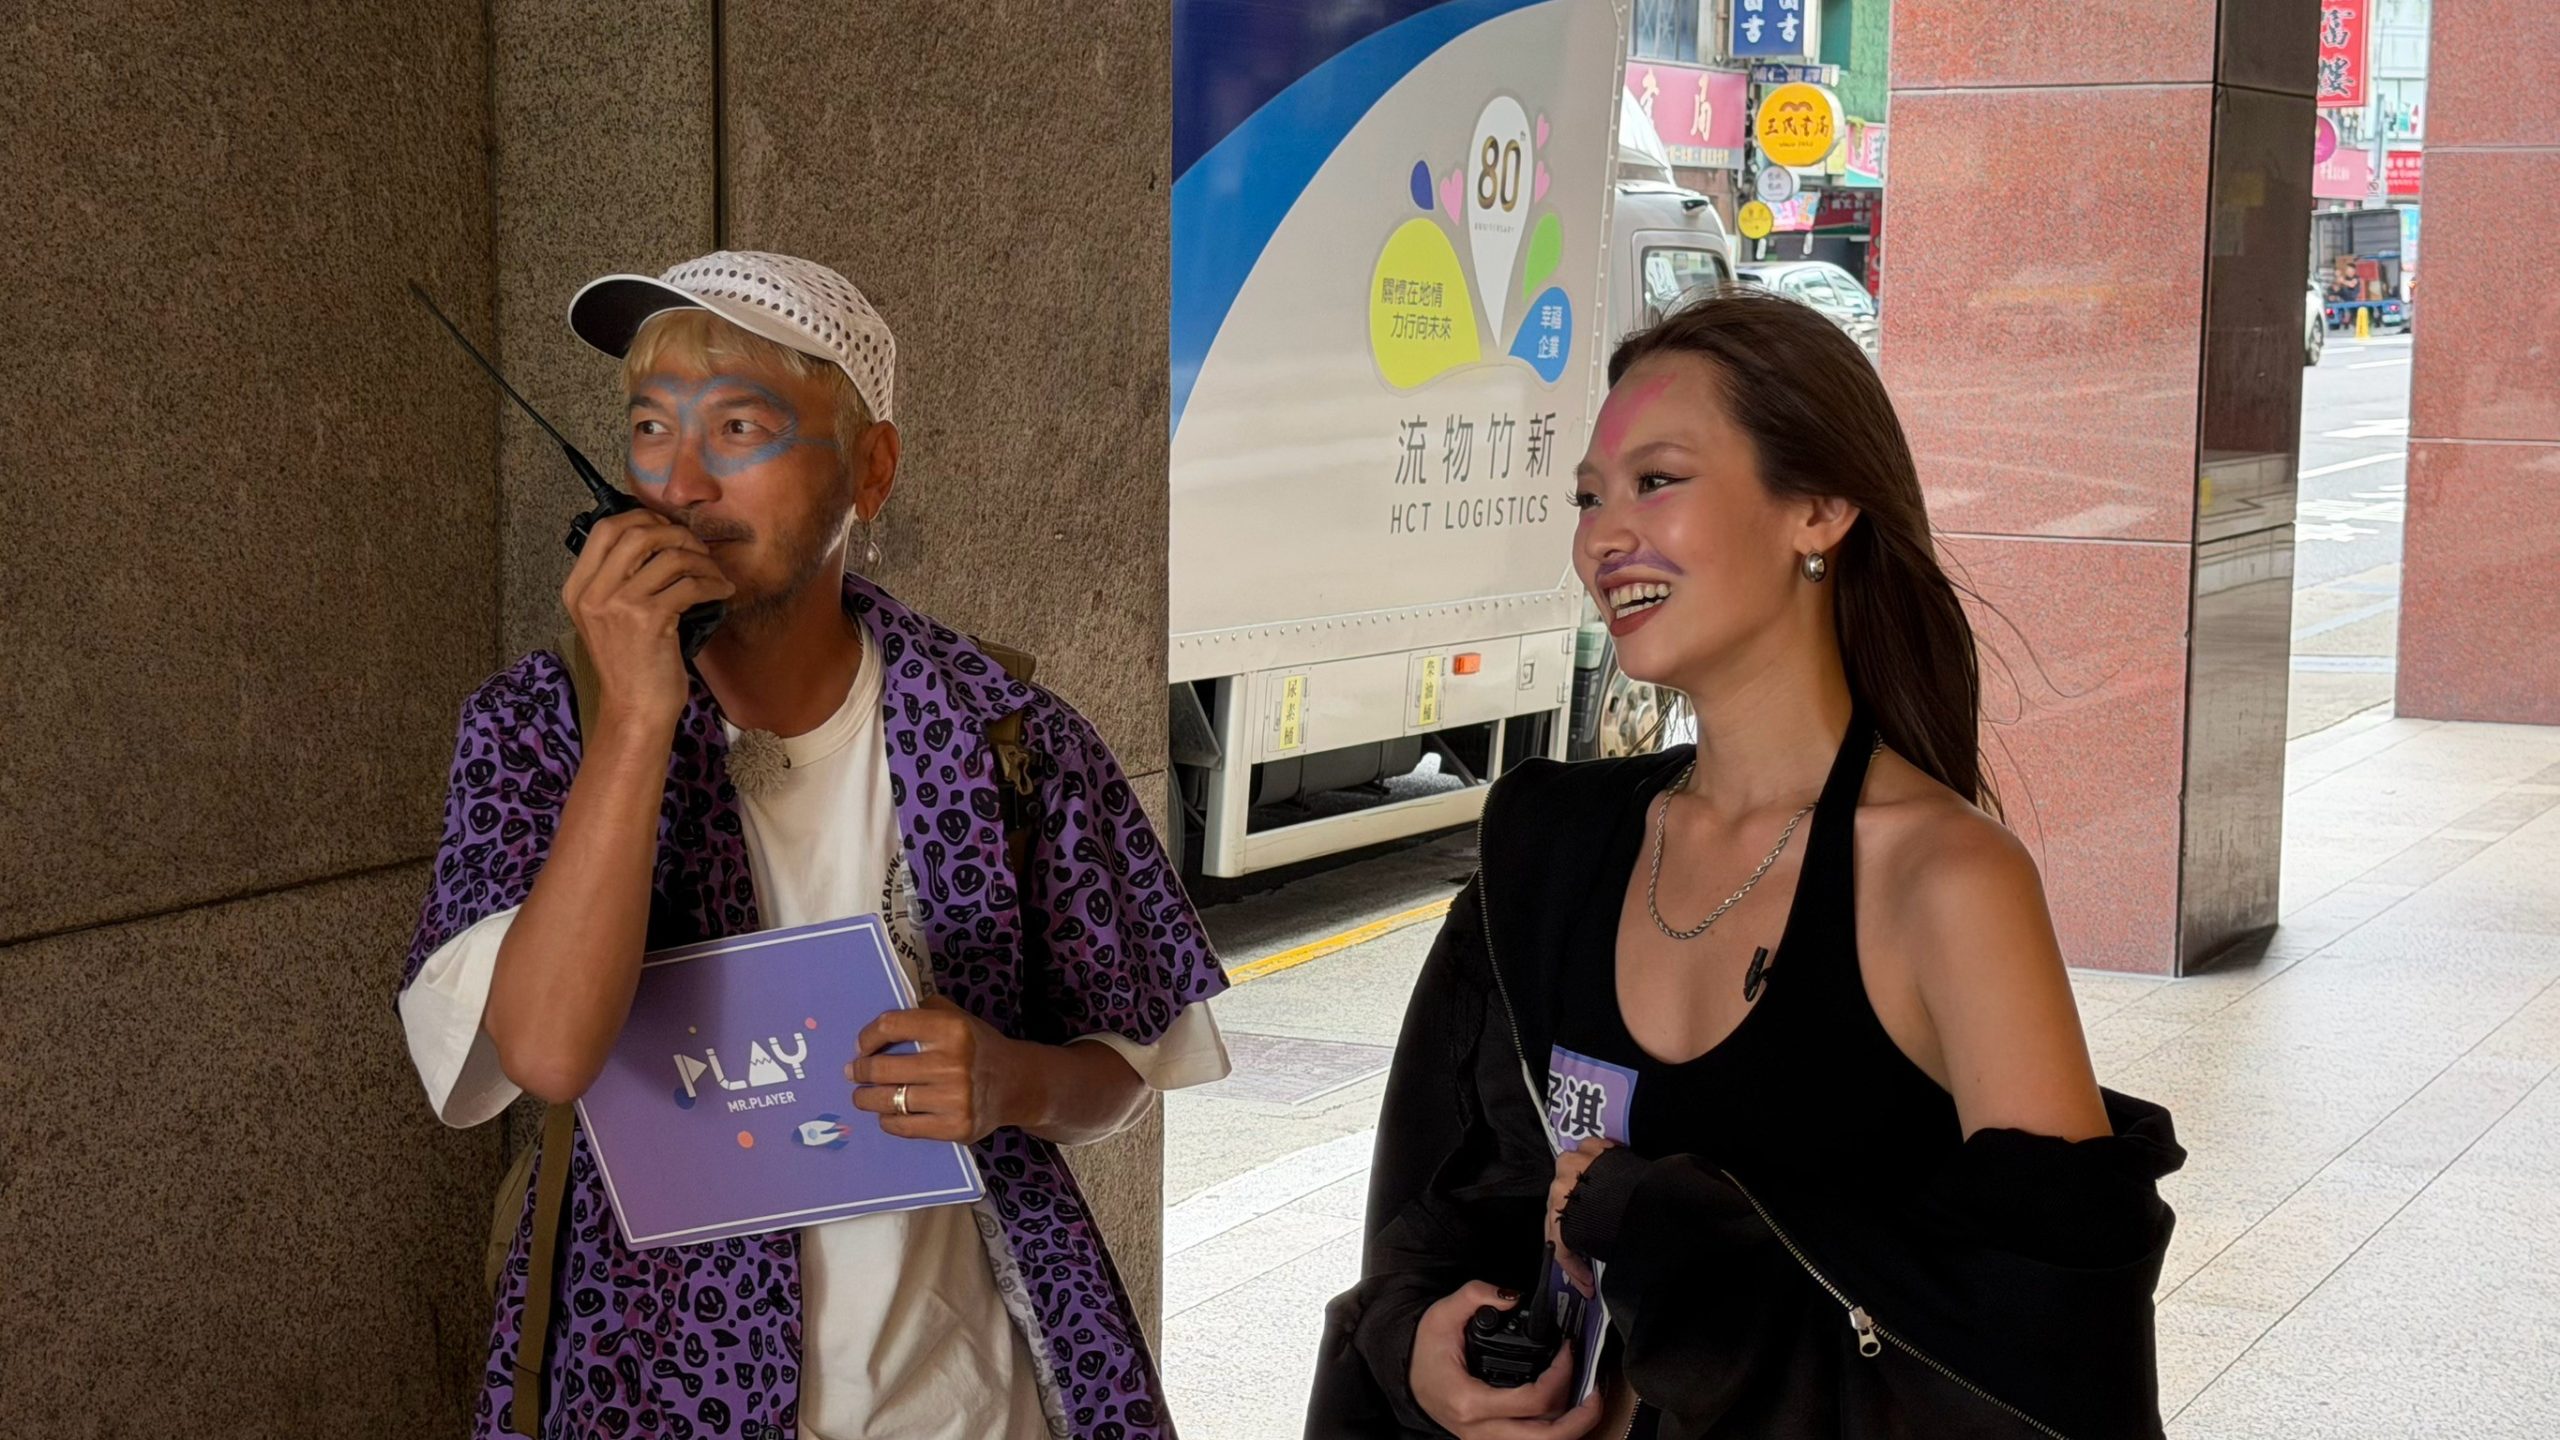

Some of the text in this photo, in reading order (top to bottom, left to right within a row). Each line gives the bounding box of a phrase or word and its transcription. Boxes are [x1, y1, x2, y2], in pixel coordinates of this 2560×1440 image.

[1765, 115, 1830, 137] 三民書局
[1381, 277, 1443, 308] 關懷在地情
[1390, 312, 1453, 340] 力行向未來
[1390, 494, 1549, 534] HCT LOGISTICS
[673, 1032, 808, 1098] PLAY
[727, 1091, 797, 1113] MR.PLAYER
